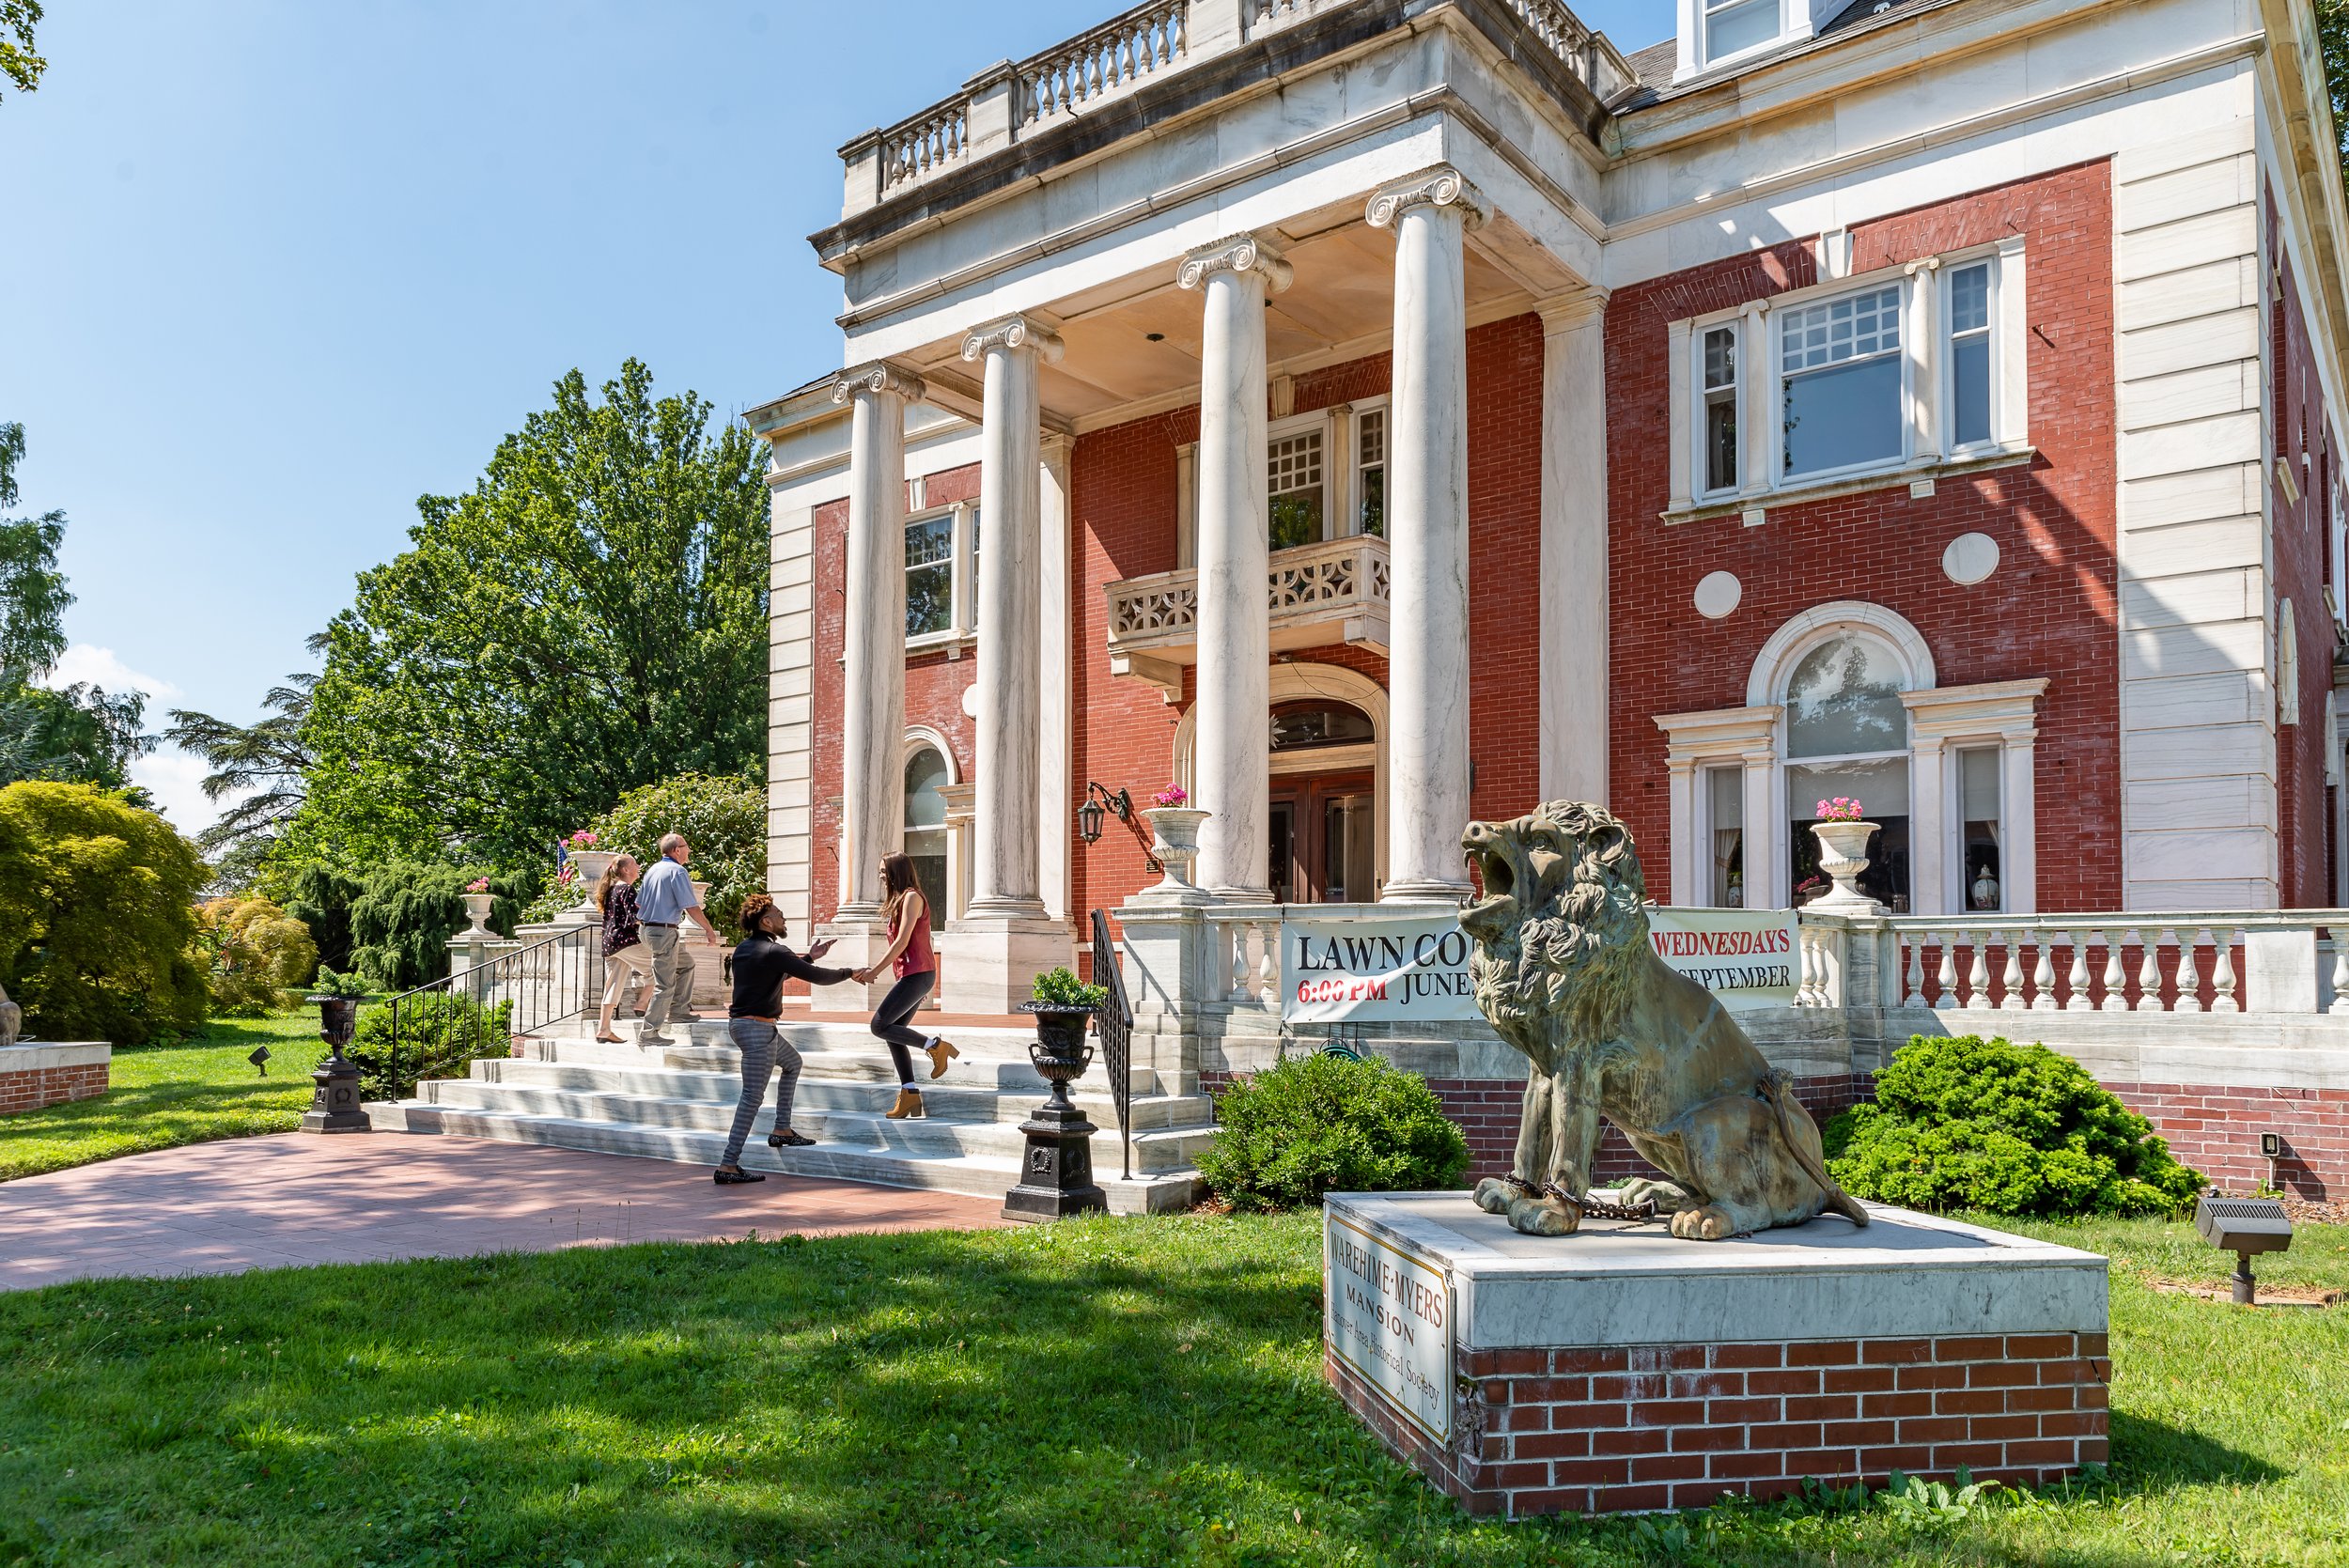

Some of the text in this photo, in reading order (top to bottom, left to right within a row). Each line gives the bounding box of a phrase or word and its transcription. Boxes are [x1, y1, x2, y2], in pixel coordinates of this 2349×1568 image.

[1298, 928, 1791, 971] LAWN CO WEDNESDAYS
[1298, 979, 1345, 1003] 6:00
[1348, 978, 1389, 1001] PM
[1346, 1283, 1415, 1347] MANSION
[1330, 1301, 1439, 1410] Hanover Area Historical Society
